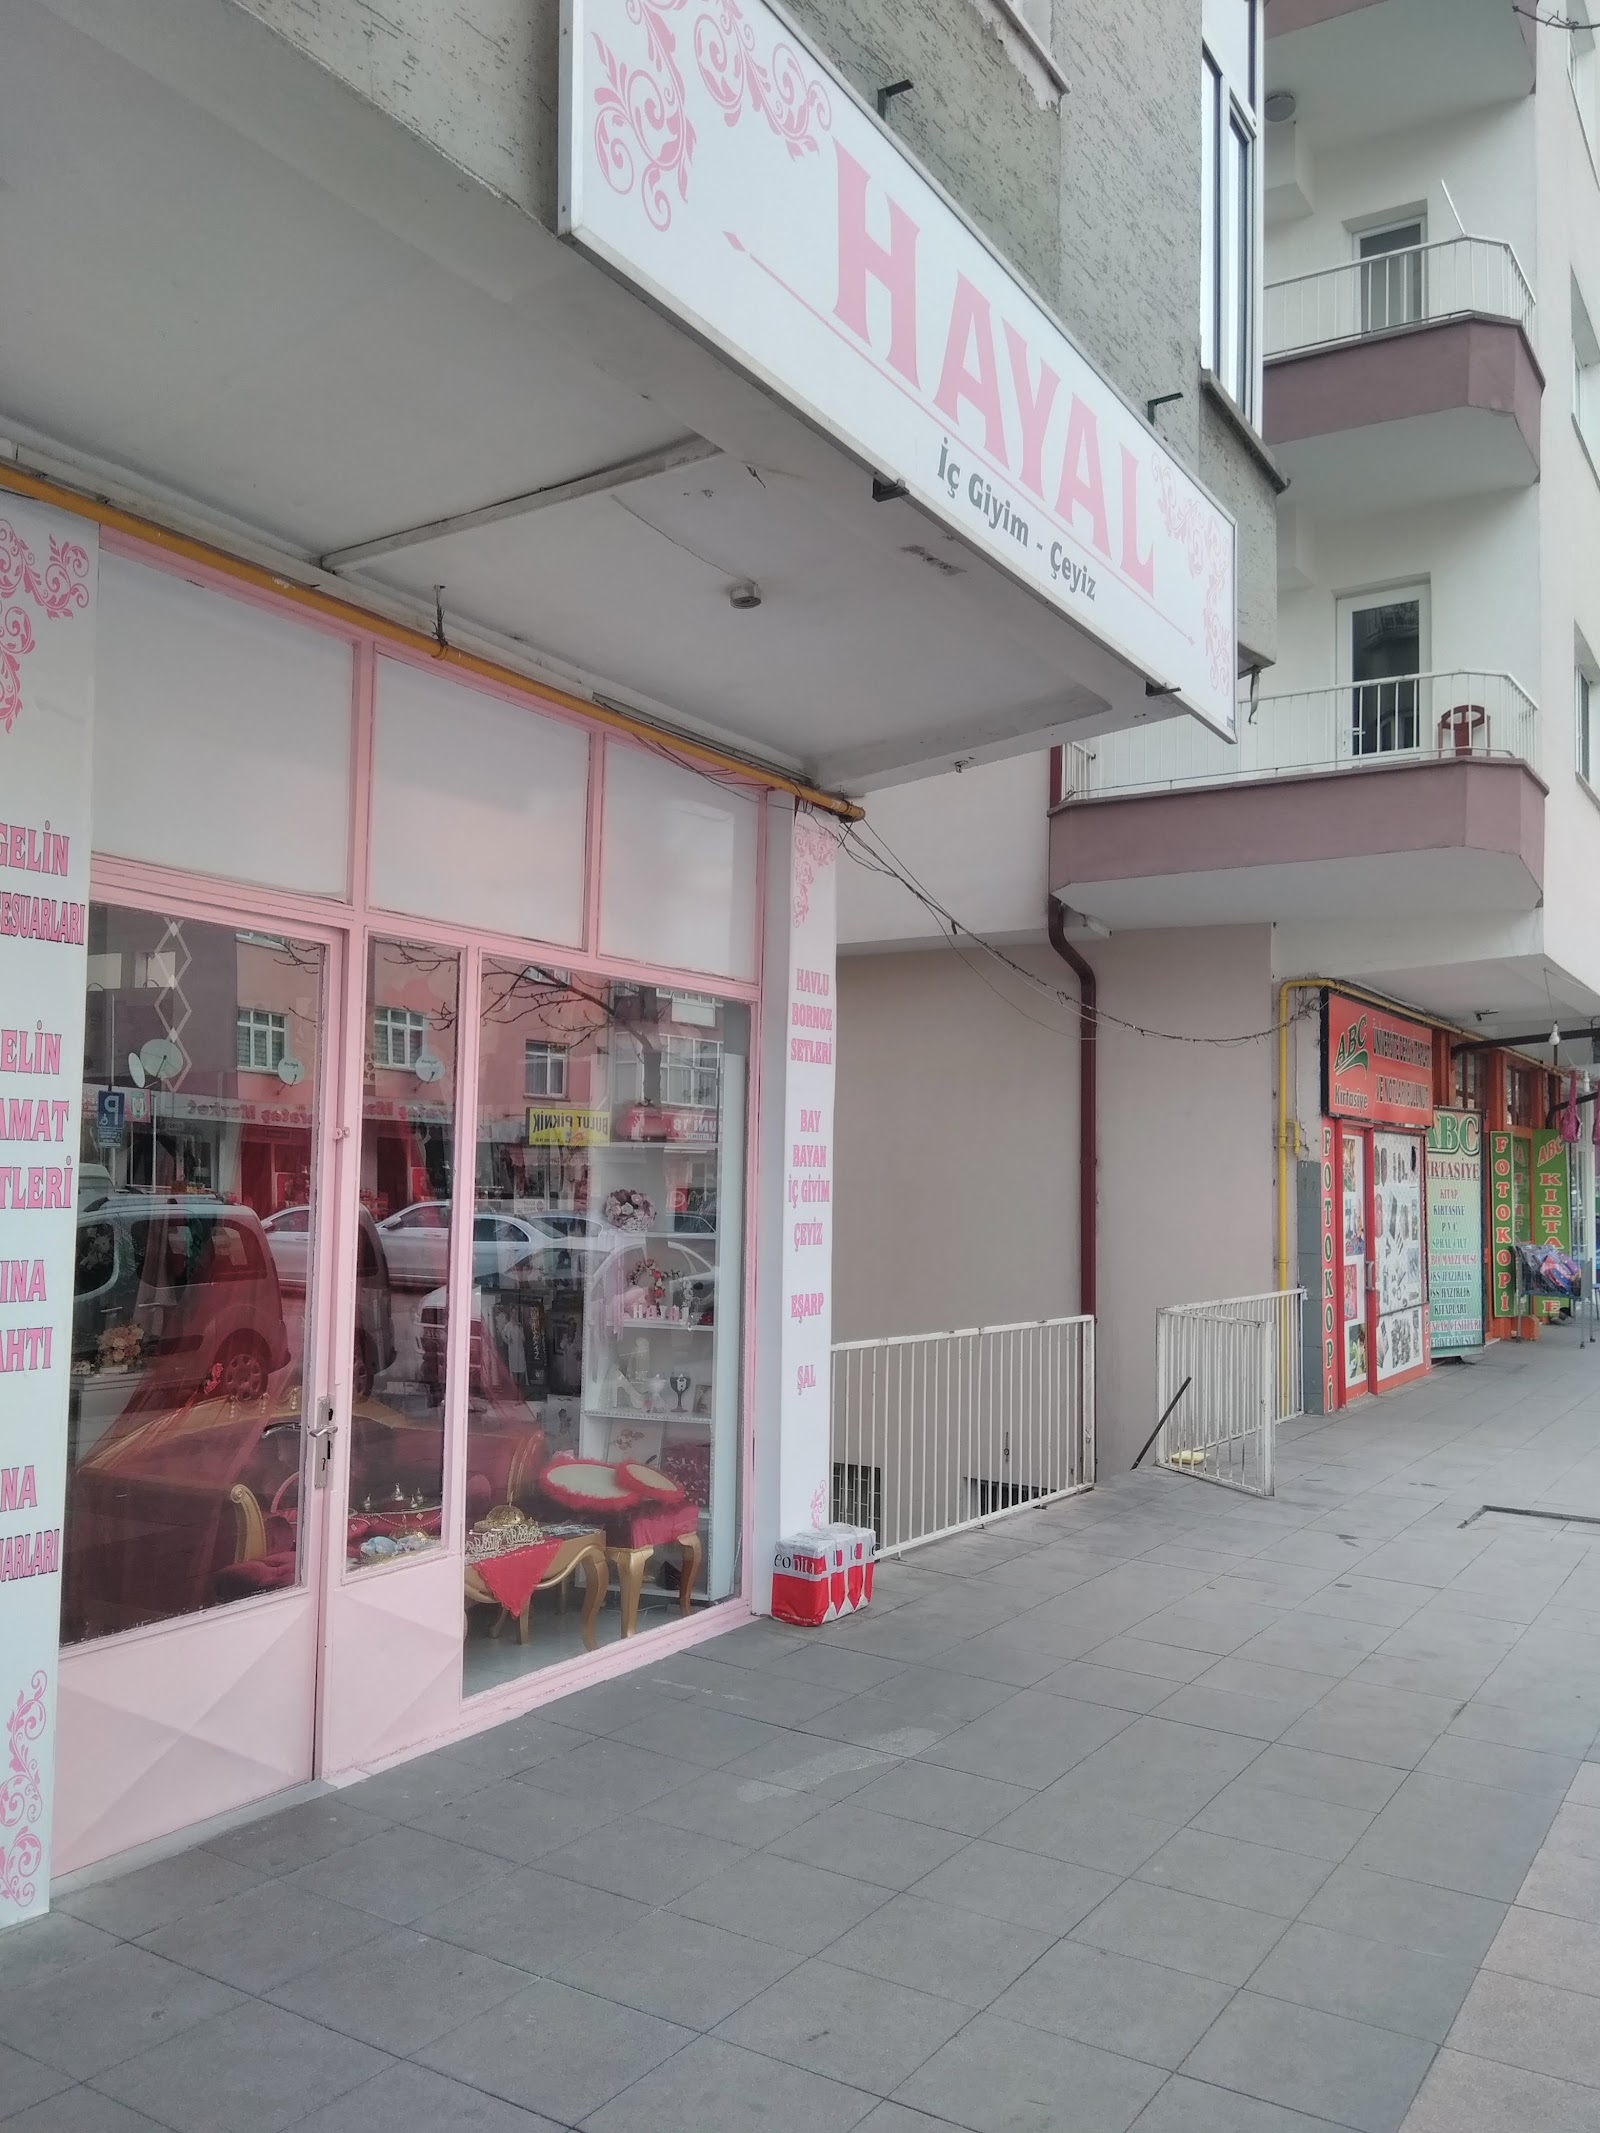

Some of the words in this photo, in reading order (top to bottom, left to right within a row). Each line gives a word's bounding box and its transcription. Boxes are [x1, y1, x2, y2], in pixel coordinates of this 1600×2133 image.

[832, 134, 1155, 601] HAYAL
[936, 436, 960, 499] İç
[968, 471, 1030, 548] Giyim
[1049, 540, 1096, 602] Çeyiz
[0, 891, 86, 946] ESUARLARI
[796, 968, 830, 997] HAVLU
[791, 1002, 833, 1031] BORNOZ
[790, 1037, 833, 1065] SETLERİ
[1334, 1013, 1368, 1072] ABC
[800, 1109, 822, 1133] BAY
[792, 1144, 827, 1168] BAYAN
[1537, 1135, 1565, 1167] ABC
[788, 1174, 799, 1209] İÇ
[801, 1173, 830, 1202] GİYİM
[793, 1216, 823, 1252] ÇEYİZ
[1494, 1136, 1512, 1312] FOTOKOPİ
[1539, 1173, 1564, 1313] KIRTAE
[1322, 1126, 1334, 1413] FOTOKOPİ
[791, 1293, 824, 1324] EŞARP
[797, 1364, 816, 1396] ŞAL
